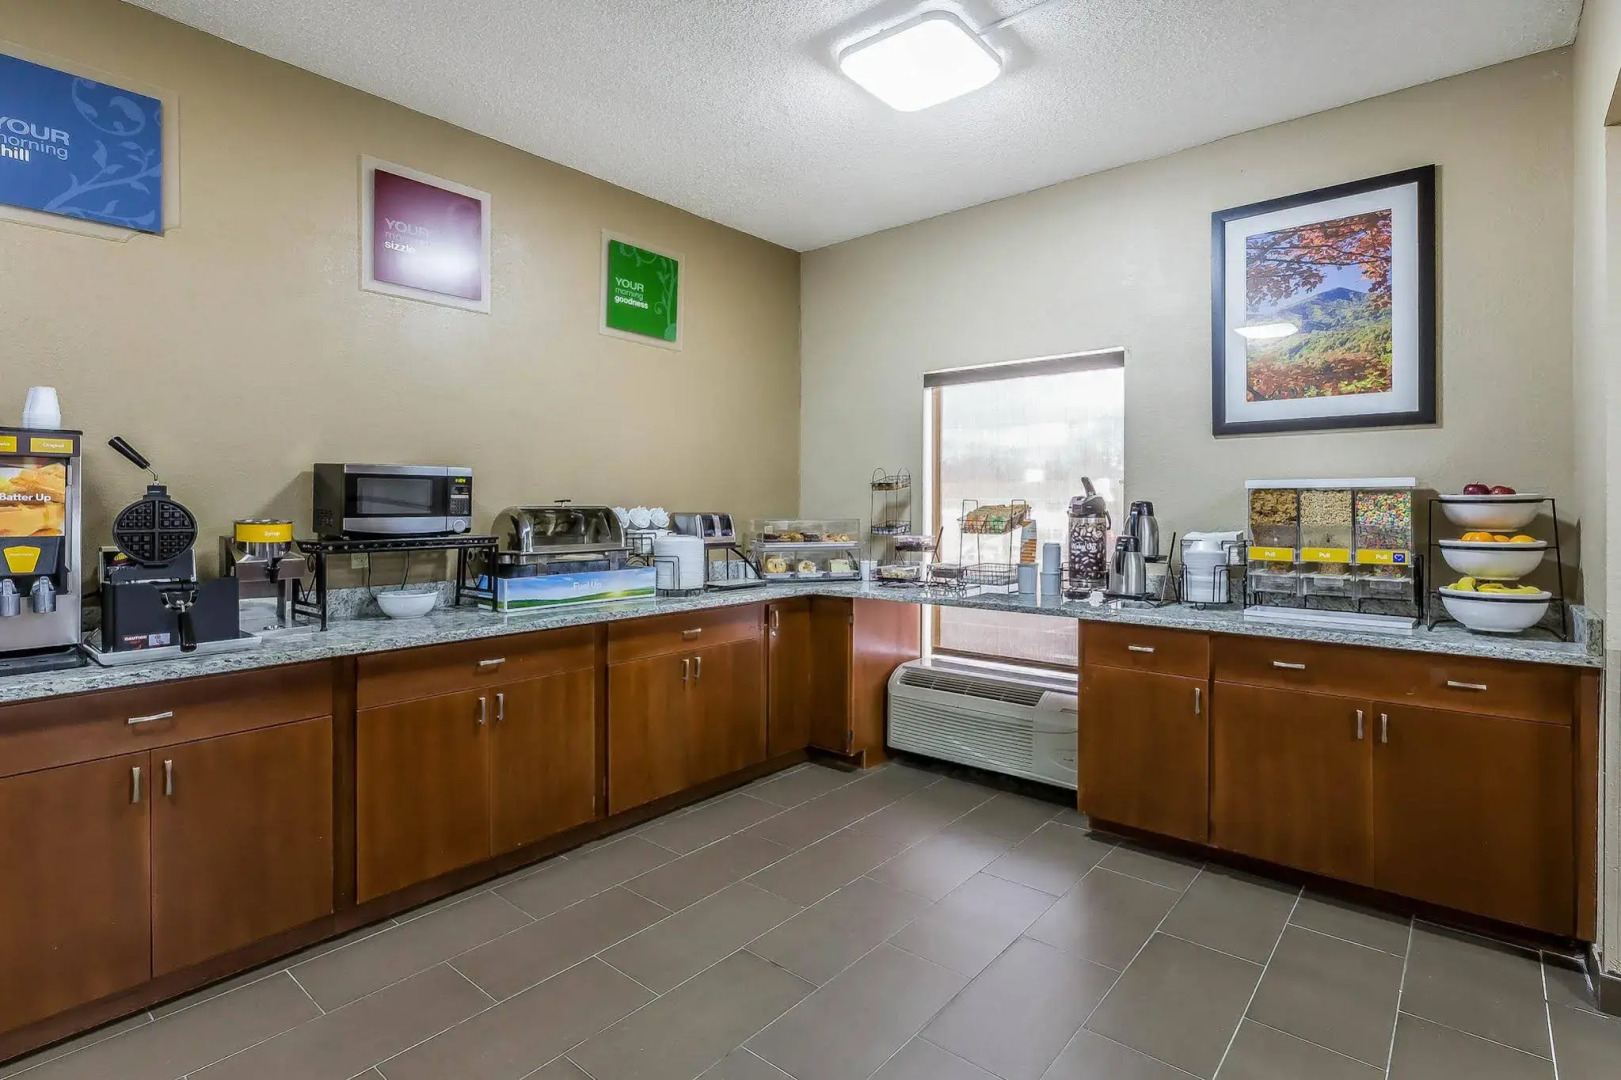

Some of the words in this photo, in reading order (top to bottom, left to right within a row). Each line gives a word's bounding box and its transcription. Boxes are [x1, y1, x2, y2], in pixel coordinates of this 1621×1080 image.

[384, 217, 430, 238] YOUR
[384, 240, 417, 255] sizzle
[615, 276, 645, 293] YOUR
[615, 287, 644, 301] morning
[614, 295, 649, 310] goodness
[0, 493, 33, 501] Batter
[35, 493, 52, 503] Up
